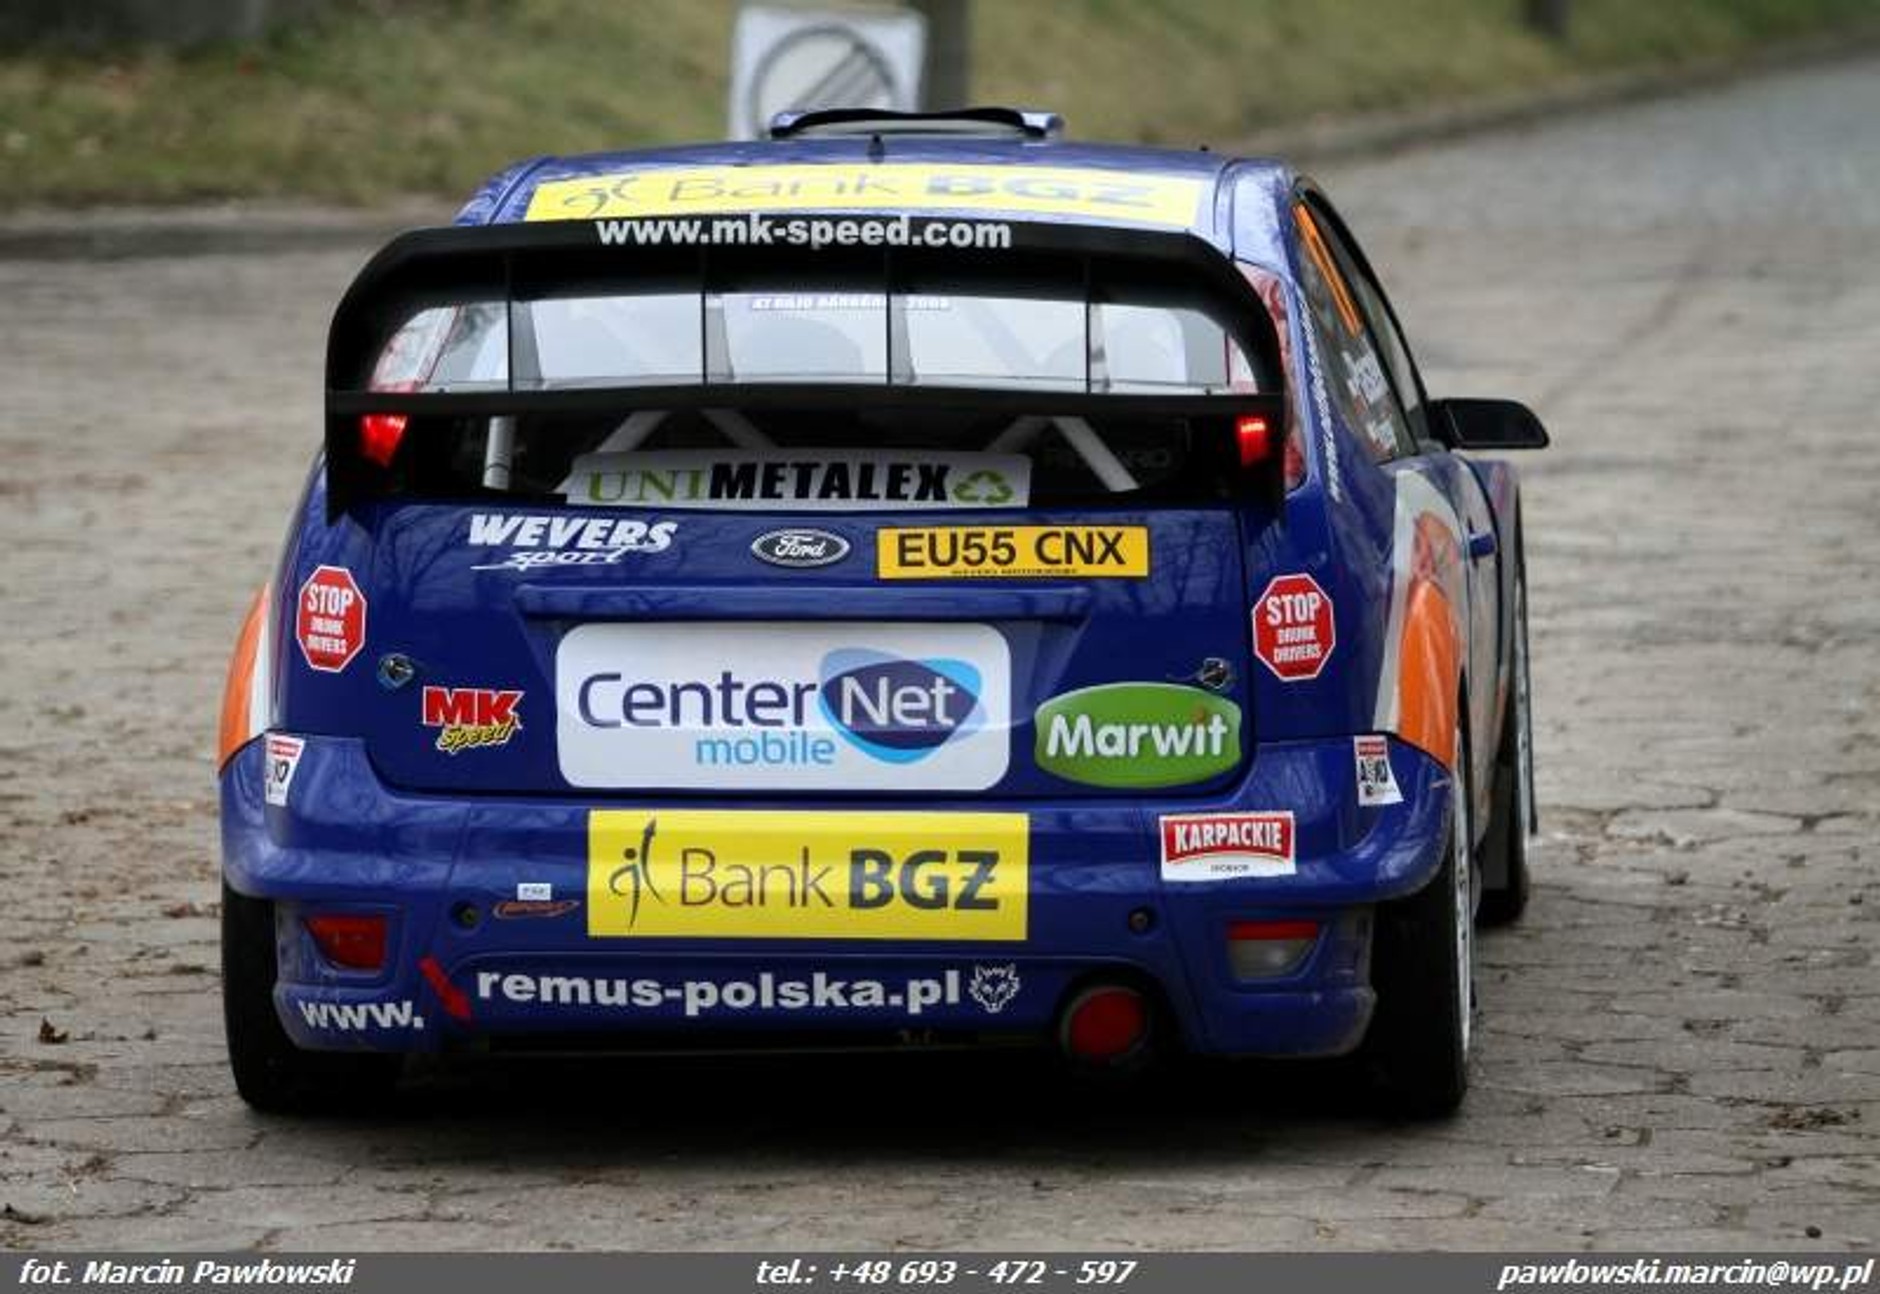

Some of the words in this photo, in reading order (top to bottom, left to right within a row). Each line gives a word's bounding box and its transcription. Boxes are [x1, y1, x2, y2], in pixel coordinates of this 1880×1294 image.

[596, 213, 1012, 250] www.mk-speed.com
[467, 513, 679, 552] WEVERS
[775, 535, 827, 557] Ford
[897, 531, 1017, 567] EU55
[1034, 530, 1127, 565] CNX
[307, 582, 354, 617] STOP
[1266, 591, 1322, 626] STOP
[423, 686, 524, 726] MK
[696, 729, 836, 766] mobile
[1046, 710, 1228, 758] Marwit
[1174, 821, 1282, 854] KARPACKIE
[680, 846, 834, 908] Bank
[299, 999, 425, 1030] www.
[477, 970, 960, 1016] remus-polska.pl
